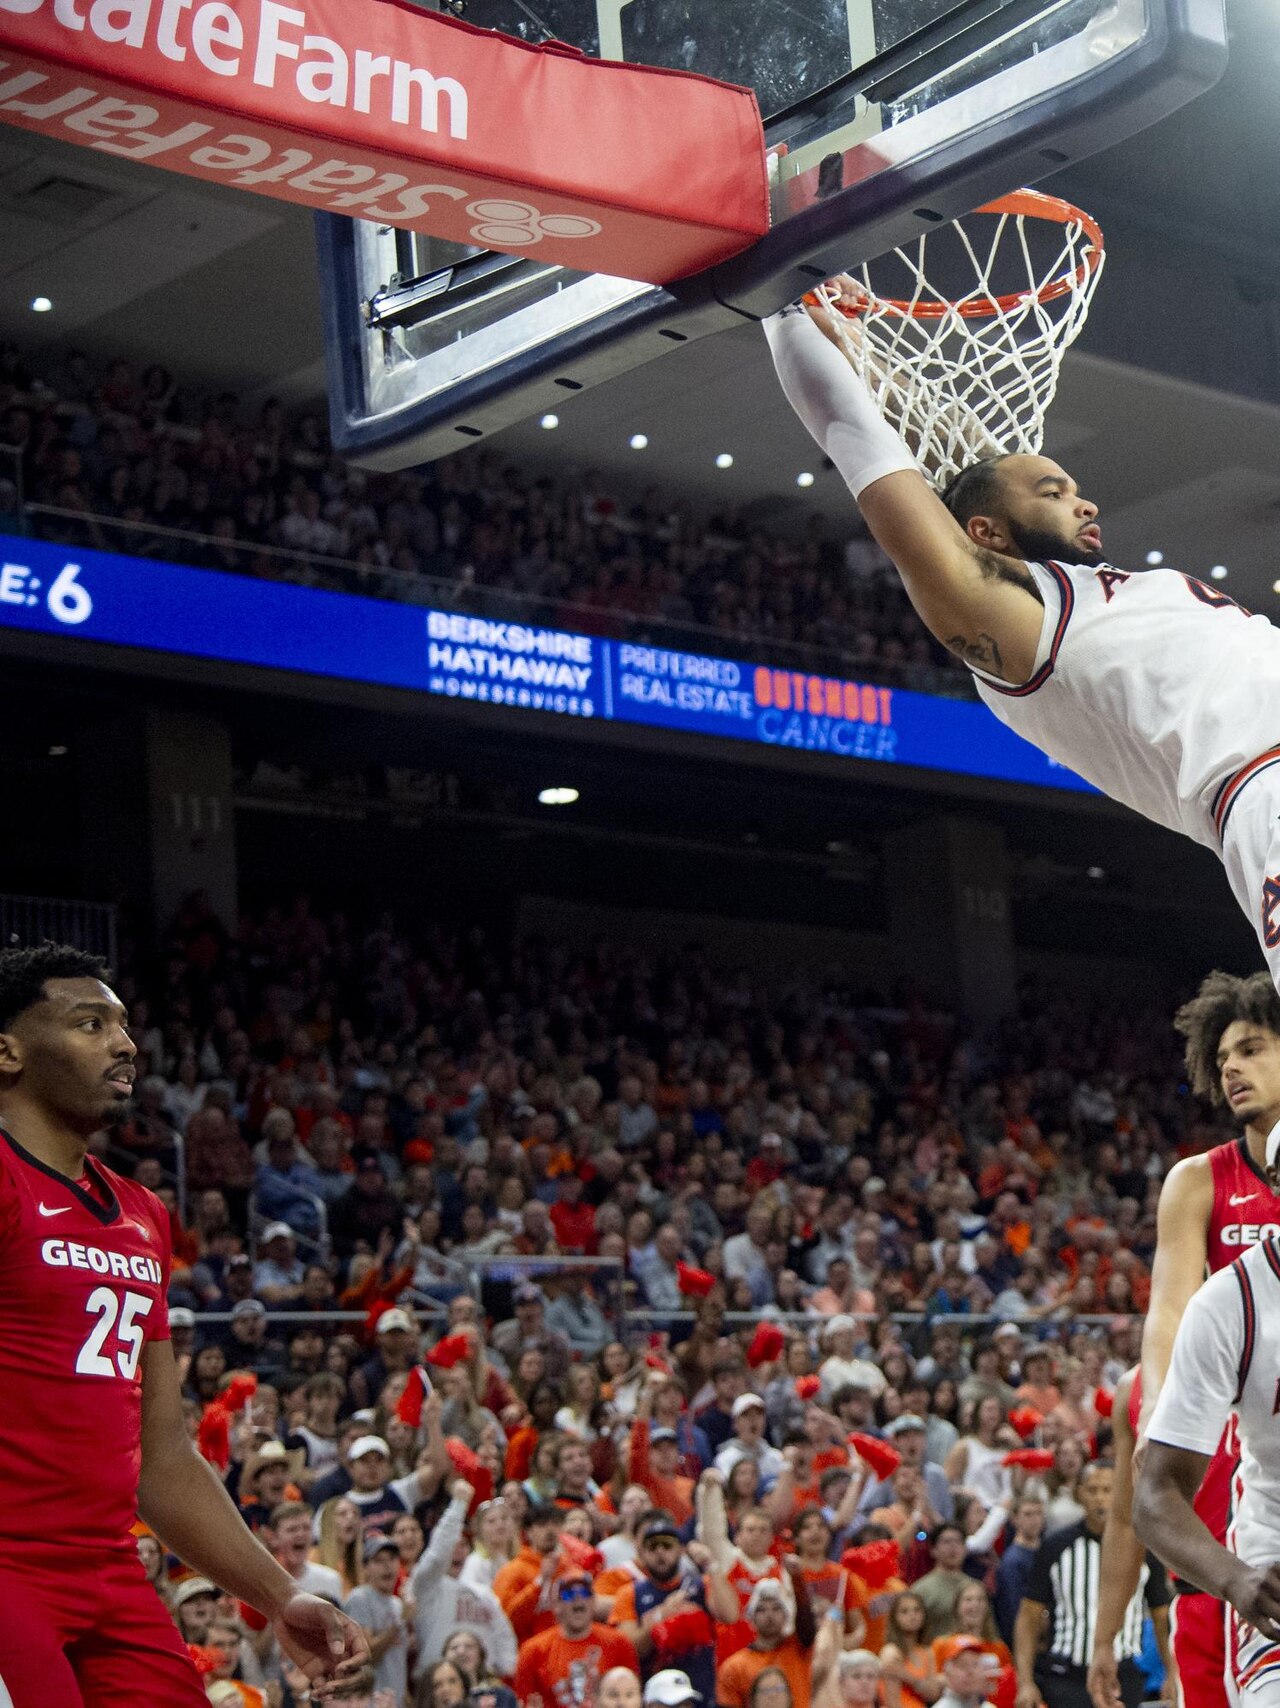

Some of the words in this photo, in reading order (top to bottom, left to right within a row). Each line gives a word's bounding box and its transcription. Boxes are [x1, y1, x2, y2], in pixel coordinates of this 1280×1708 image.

[47, 562, 93, 625] 6
[427, 611, 592, 664] BERKSHIRE
[429, 642, 592, 692] HATHAWAY
[753, 666, 893, 726] OUTSHOOT
[756, 709, 899, 763] CANCER
[75, 1286, 154, 1381] 25
